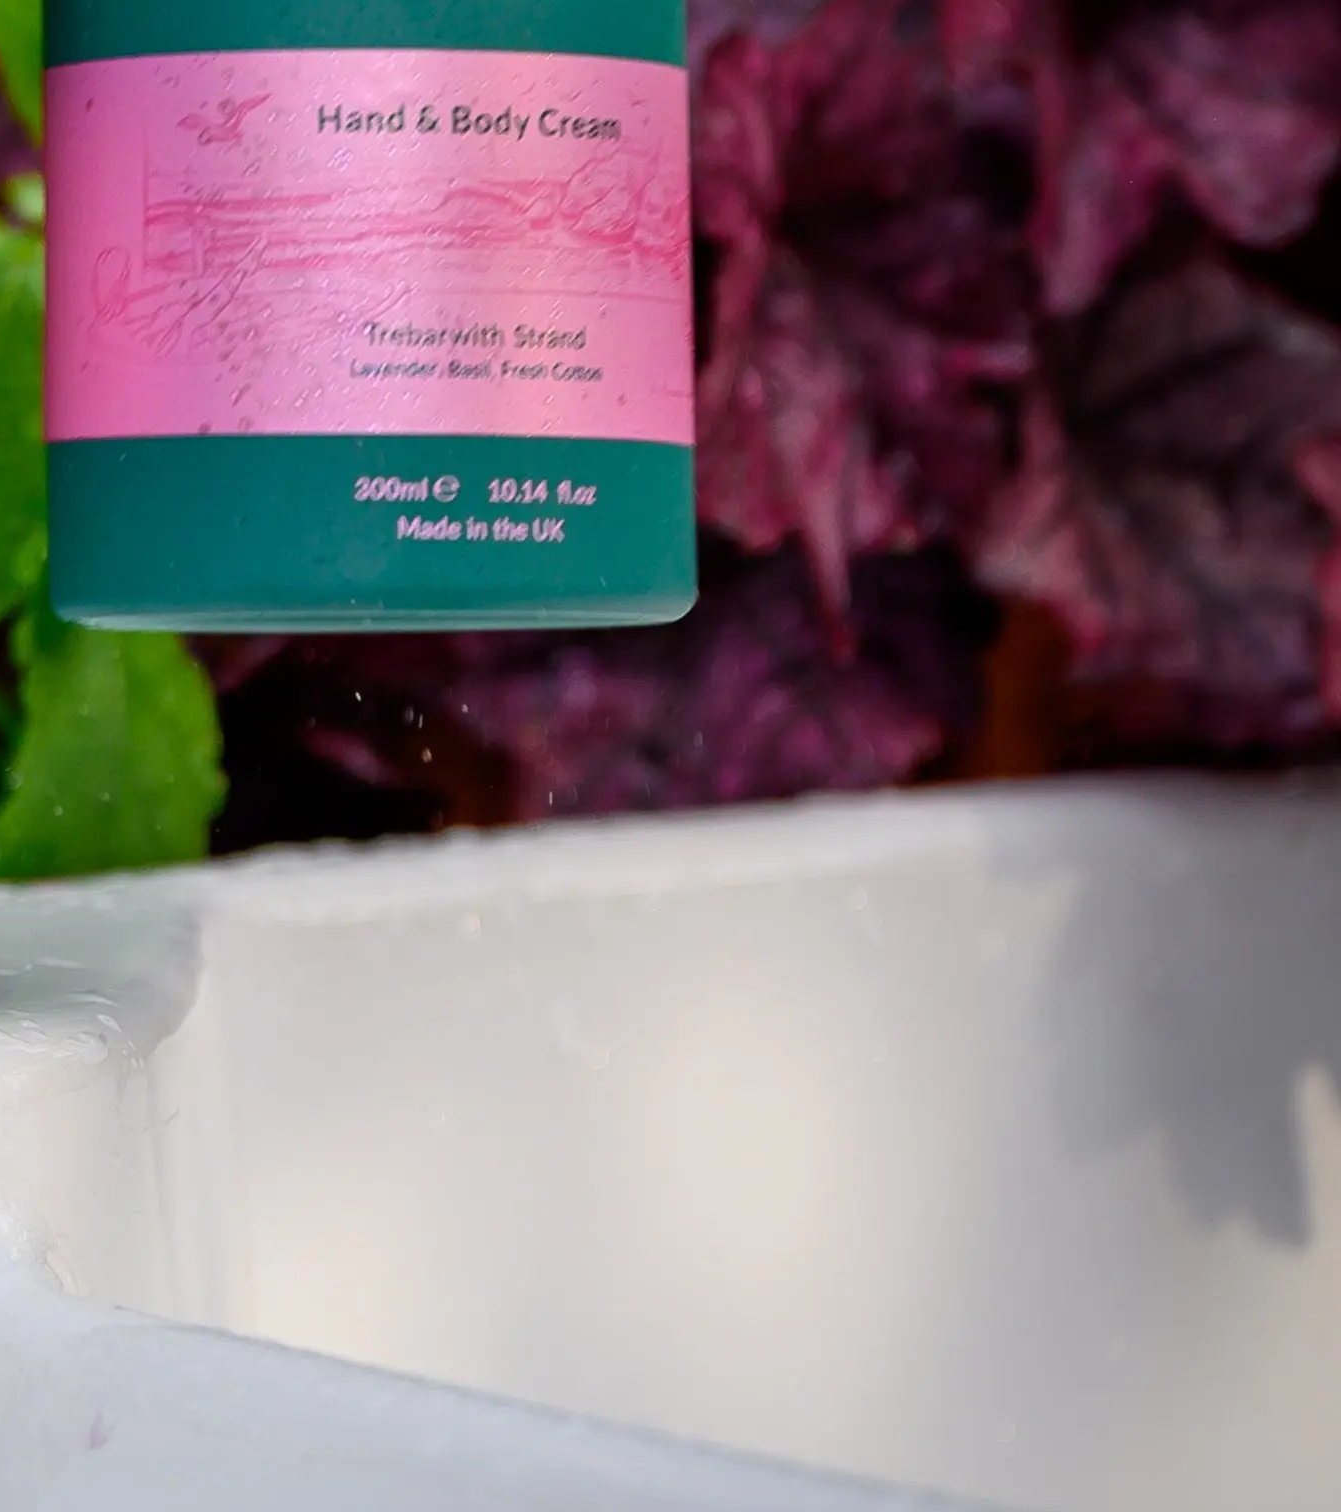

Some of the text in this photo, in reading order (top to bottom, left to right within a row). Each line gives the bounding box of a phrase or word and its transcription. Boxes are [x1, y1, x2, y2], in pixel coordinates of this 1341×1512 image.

[317, 102, 622, 141] Hand & Body Cream
[513, 323, 587, 349] Strand
[488, 477, 549, 504] 10.14
[396, 515, 566, 543] Made in the UK
